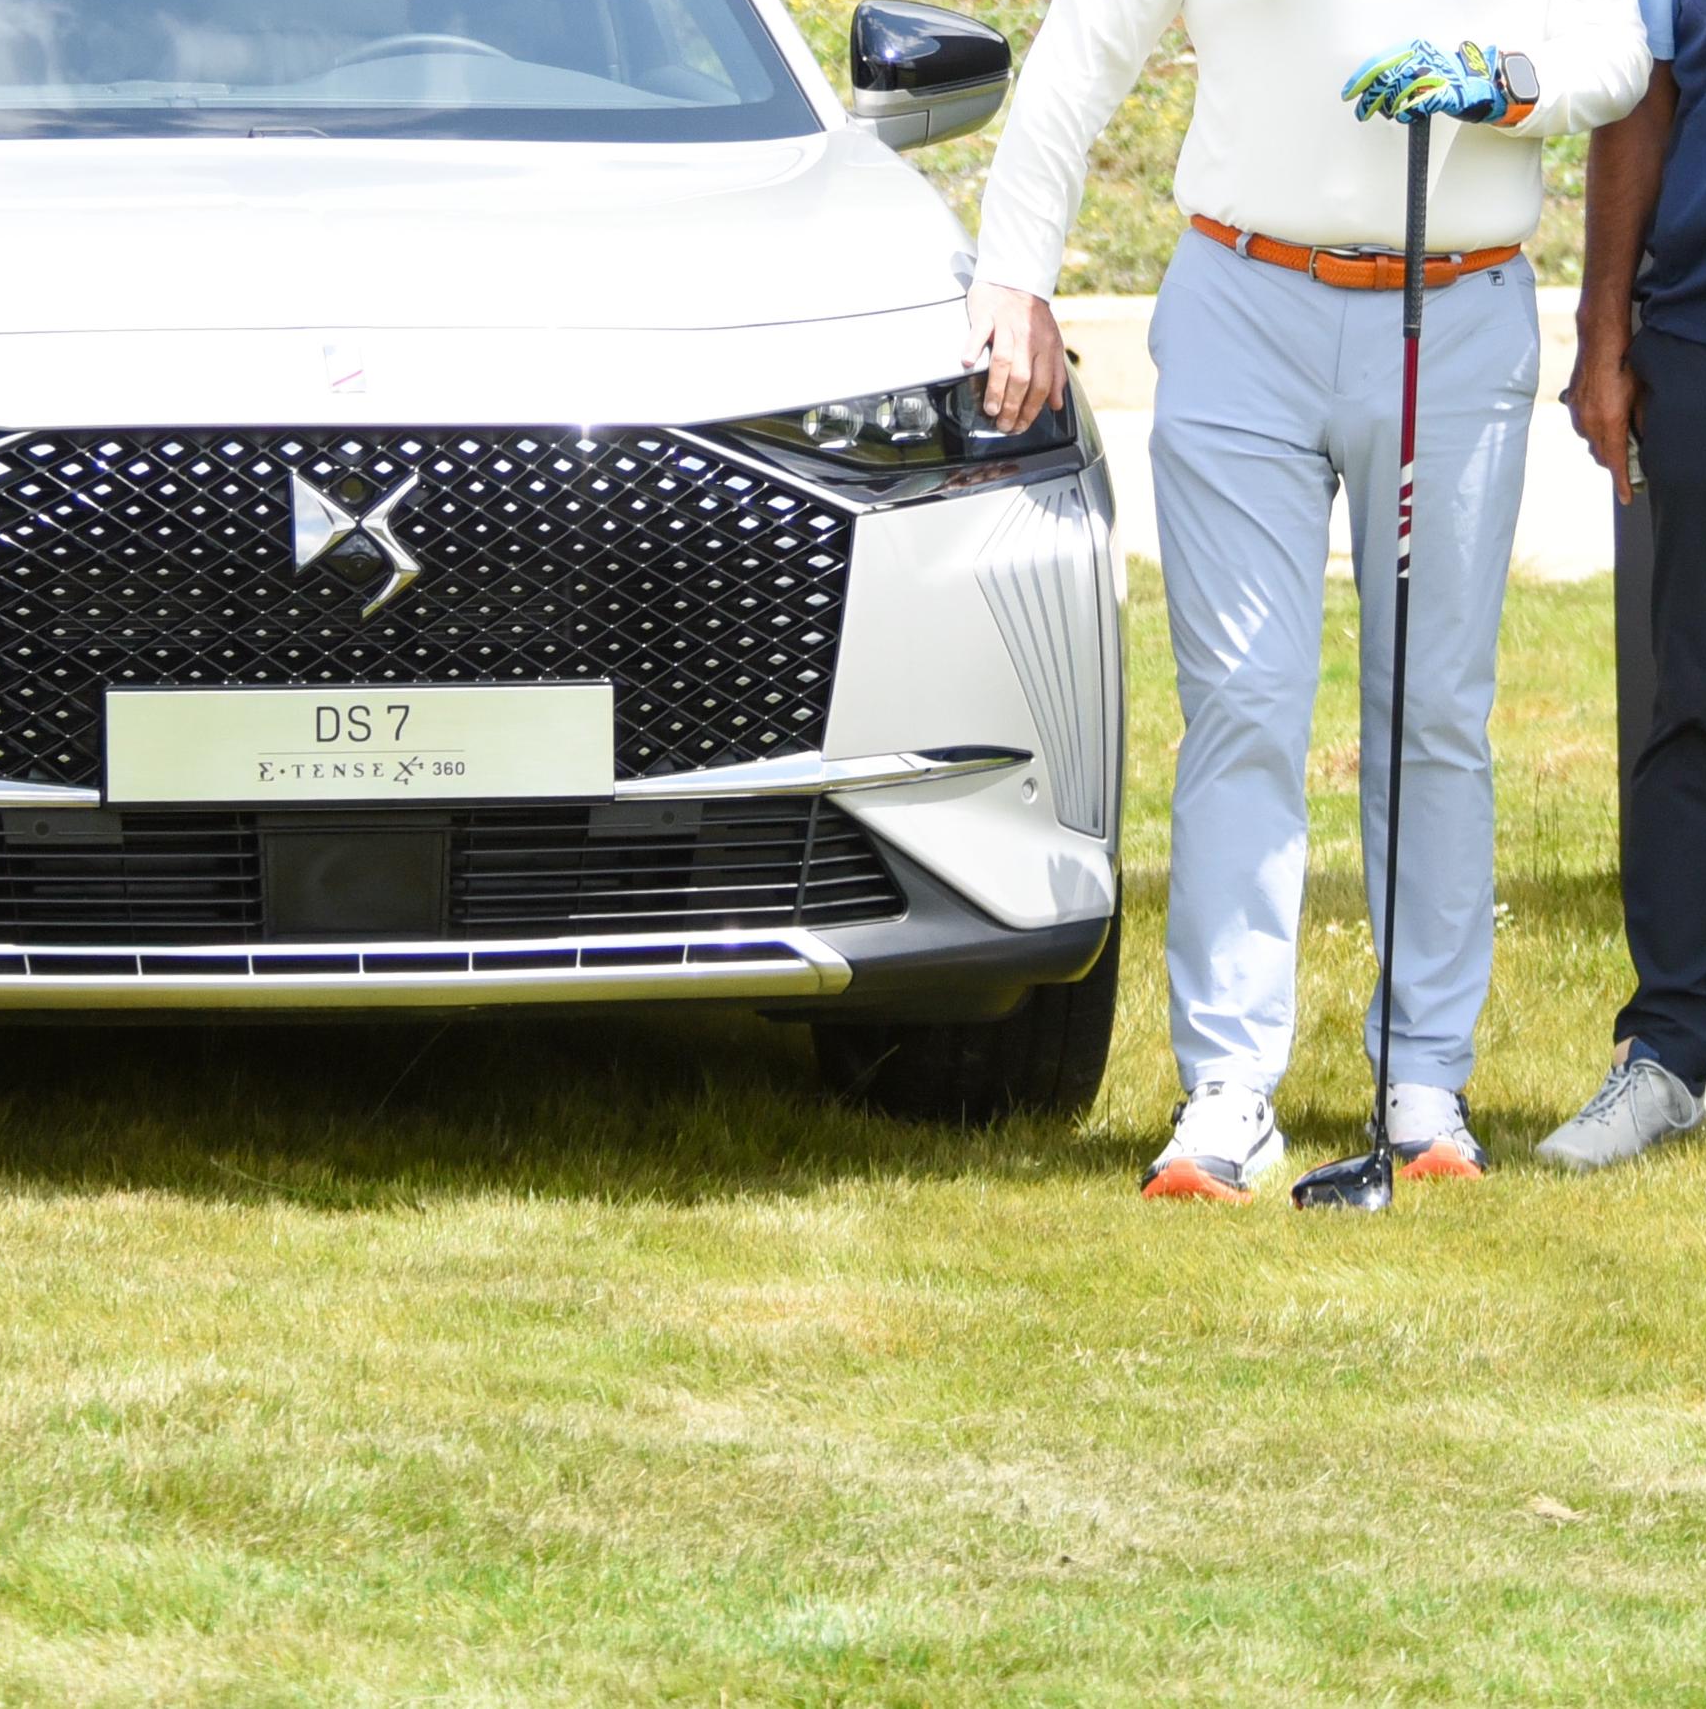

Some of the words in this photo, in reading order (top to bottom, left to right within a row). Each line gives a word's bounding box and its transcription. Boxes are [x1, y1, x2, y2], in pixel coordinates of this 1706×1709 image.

[316, 704, 372, 743] DS
[386, 704, 410, 742] 7
[432, 761, 466, 777] 360
